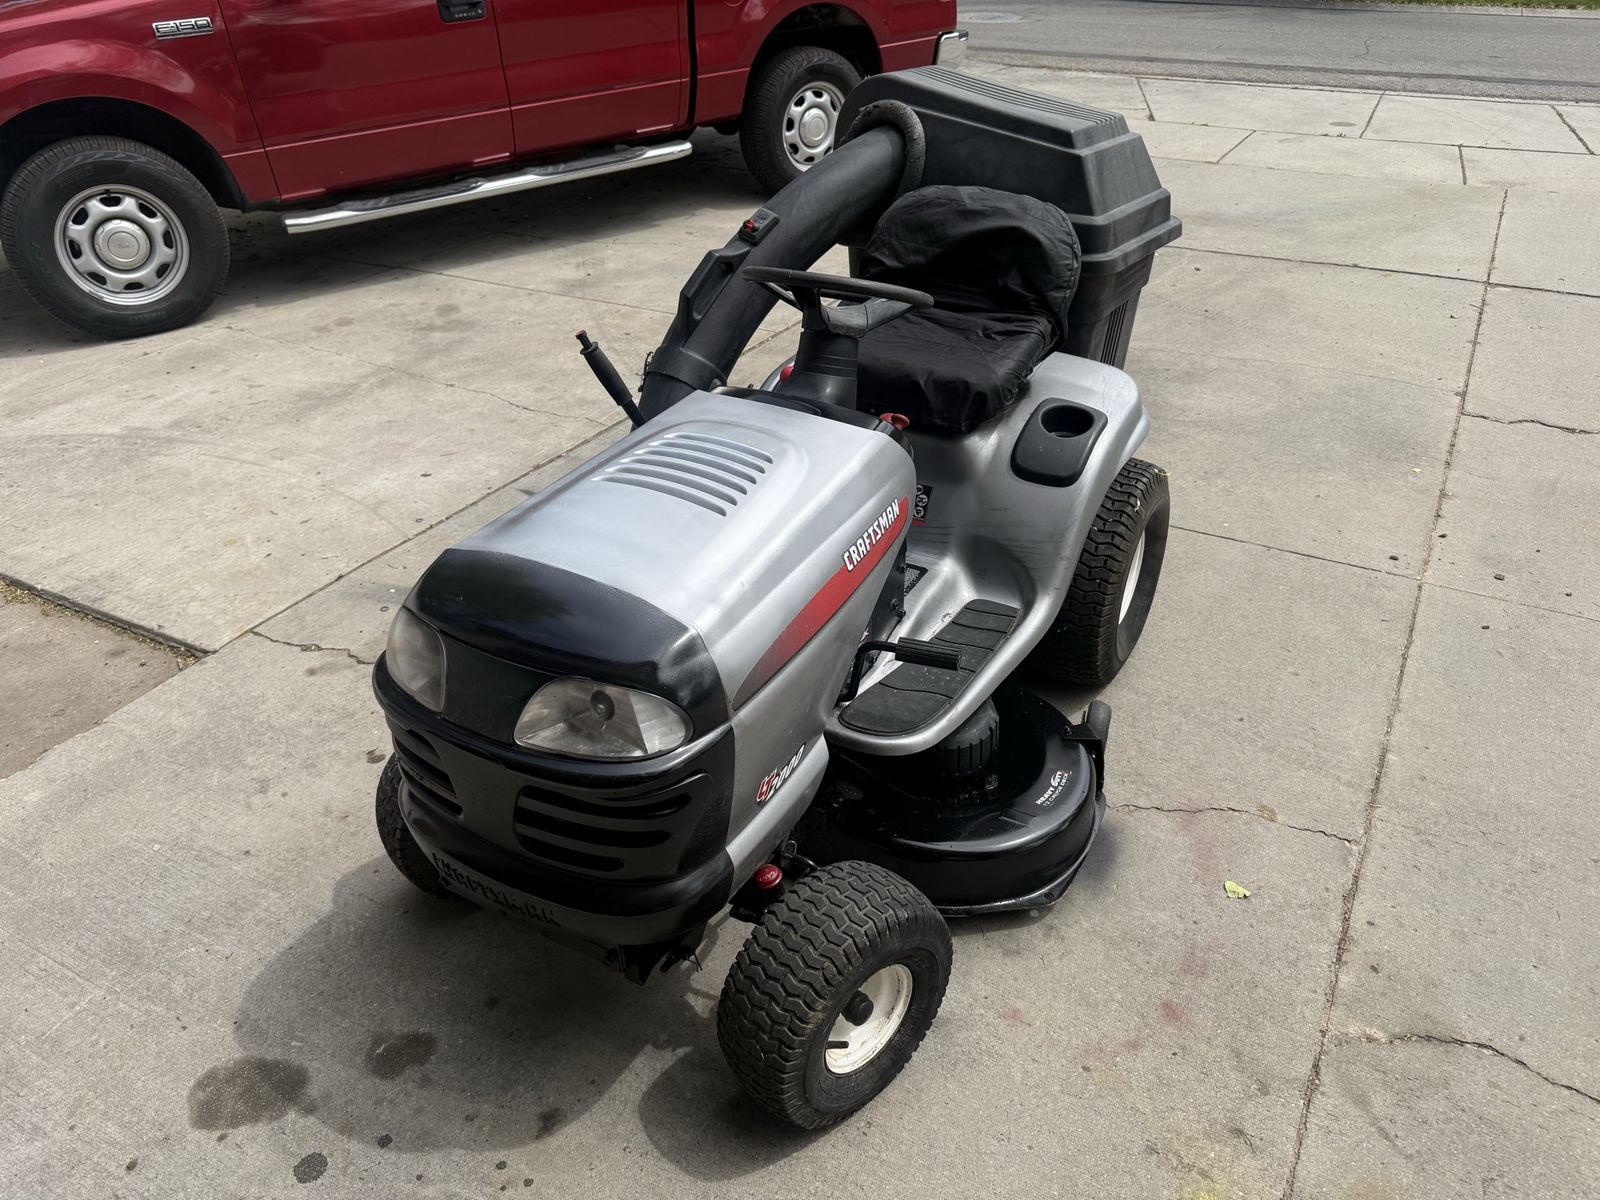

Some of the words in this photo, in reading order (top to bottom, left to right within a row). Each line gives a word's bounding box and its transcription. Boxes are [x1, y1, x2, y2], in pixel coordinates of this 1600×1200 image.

[843, 498, 900, 571] CRAFTSMAN
[1036, 786, 1055, 805] HEAVY
[1053, 771, 1062, 787] DUTY
